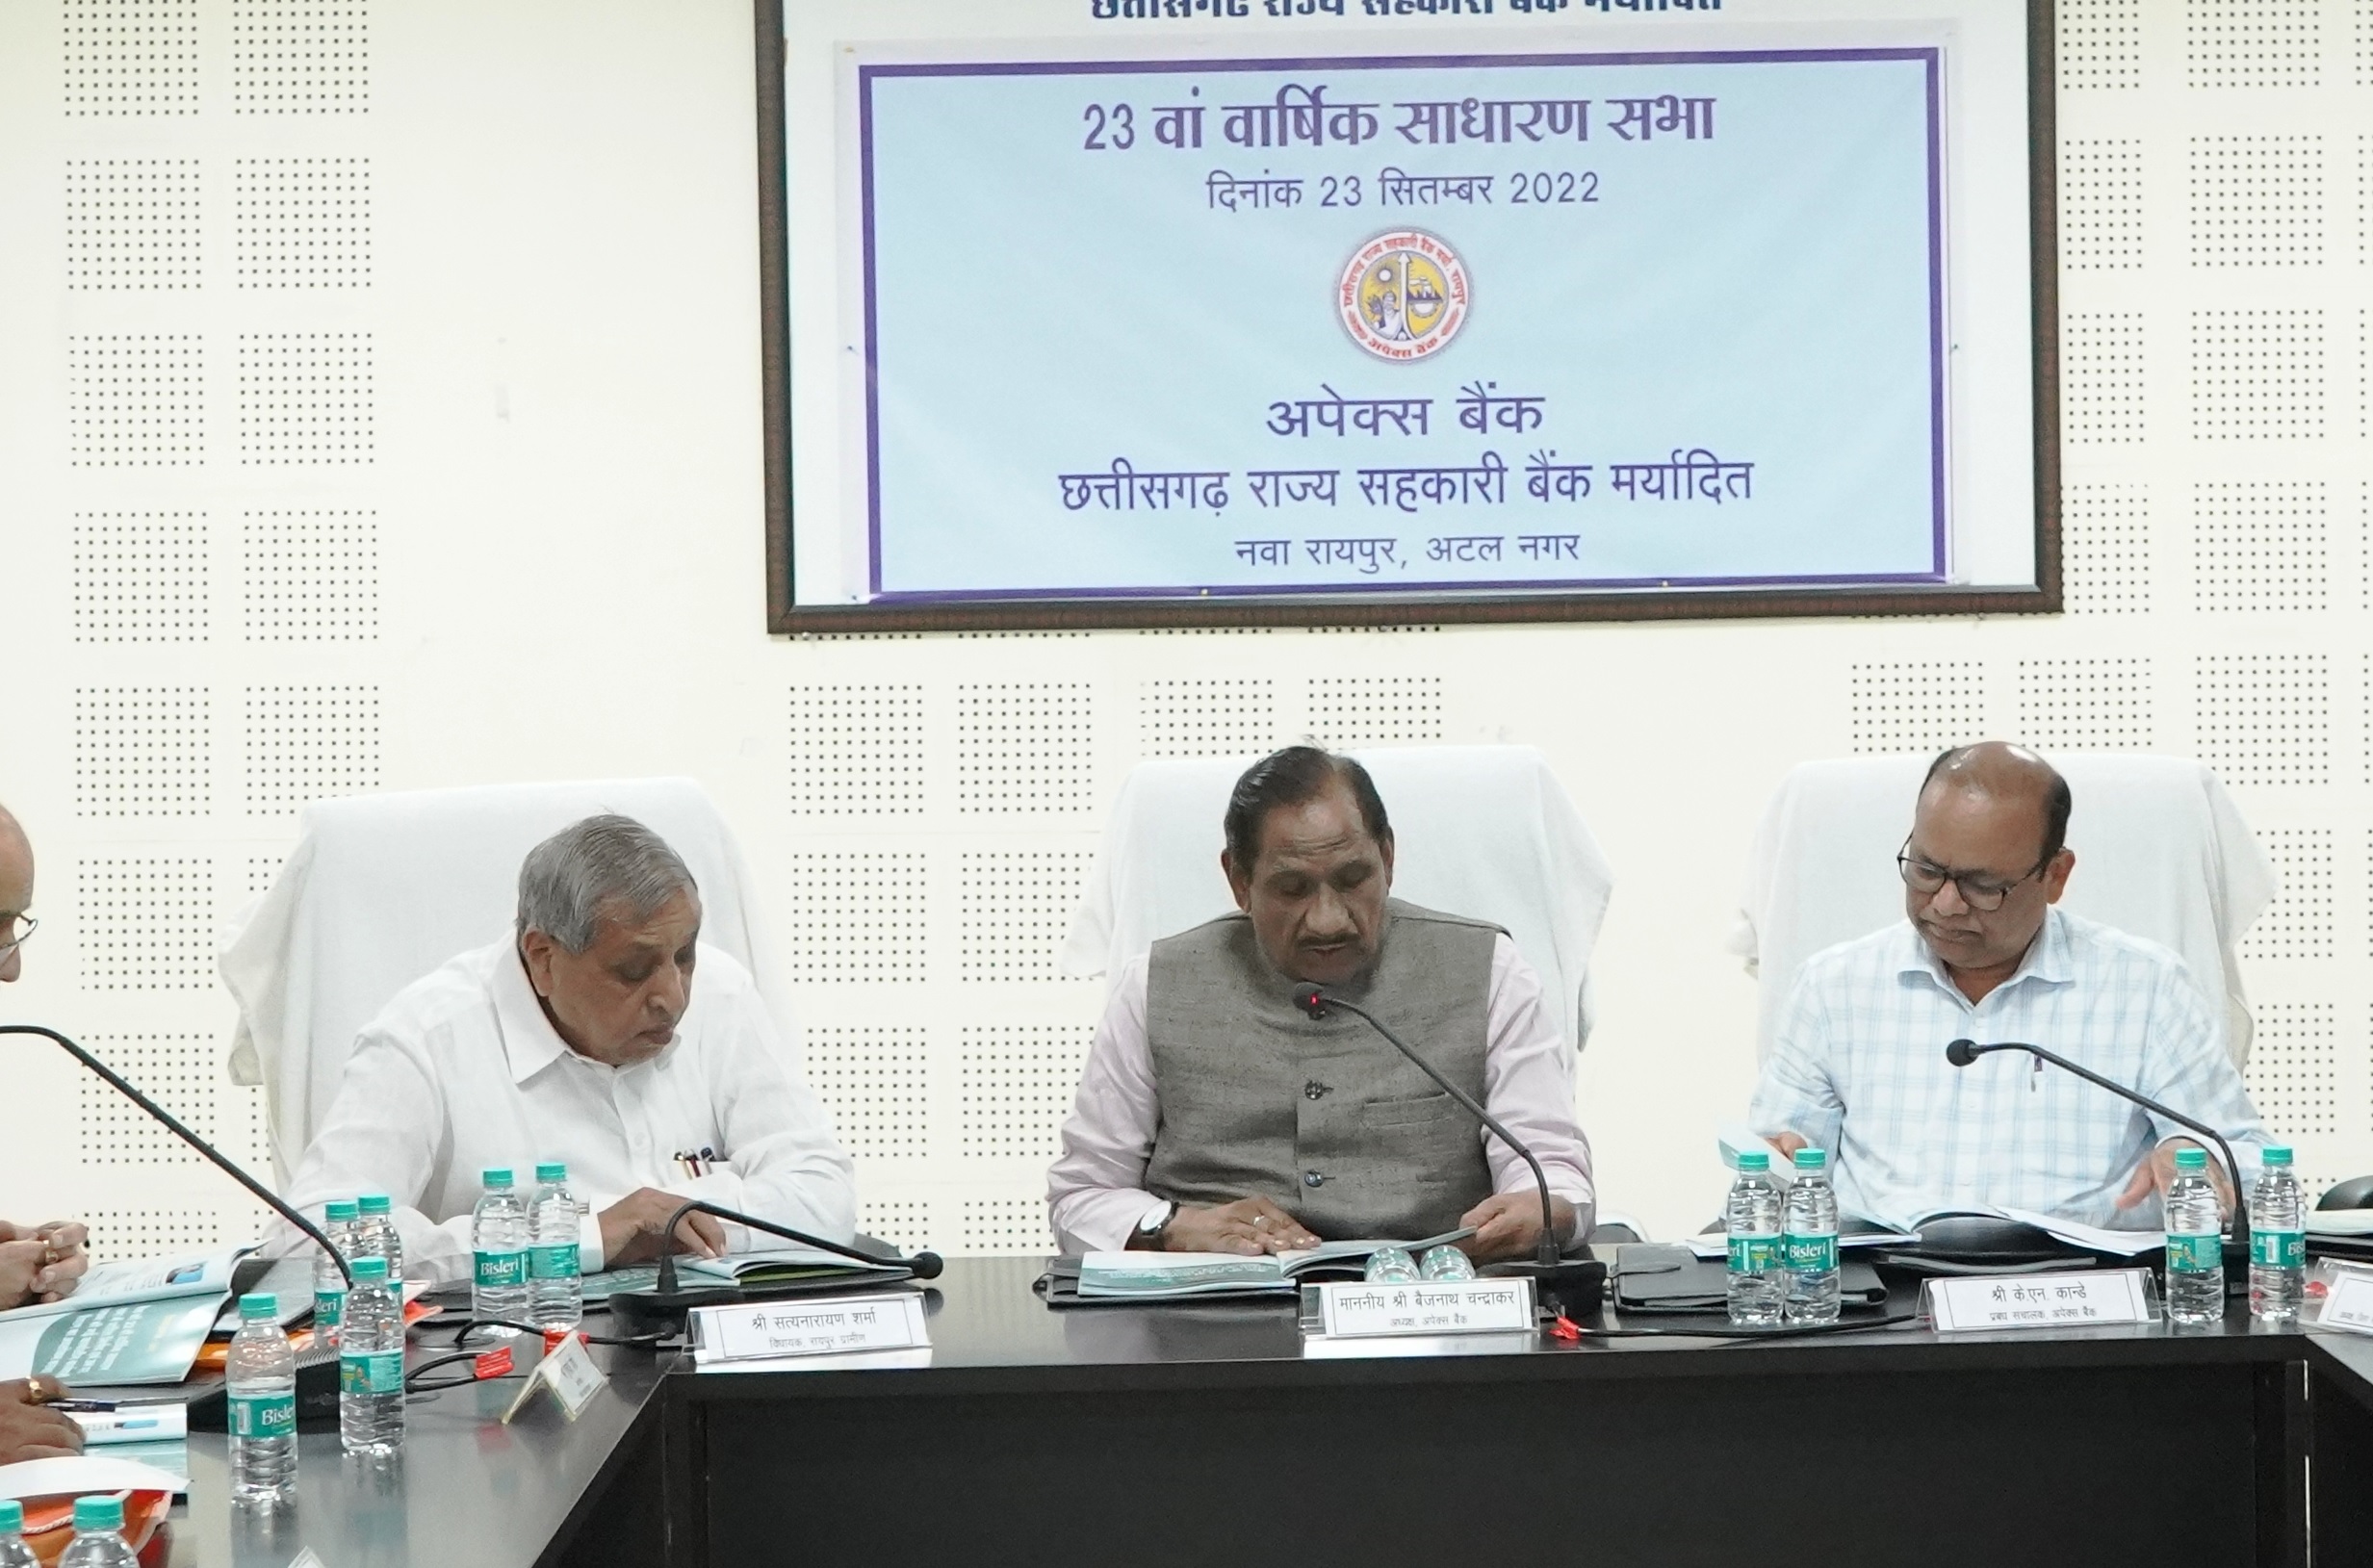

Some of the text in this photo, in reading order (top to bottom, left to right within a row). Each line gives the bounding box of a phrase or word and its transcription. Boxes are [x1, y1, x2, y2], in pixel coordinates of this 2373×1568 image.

[1083, 83, 1717, 150] 23 वां वार्षिक साधारण सभा
[1204, 166, 1599, 214] दिनांक 23 सितम्बर 2022
[1265, 379, 1547, 439] अपेक्स बैंक
[1057, 448, 1756, 518] छत्तीसगढ़ राज्य सहकारी बैंक मर्यादित
[1233, 534, 1582, 575] नवा रायपुर, अटल नगर
[481, 1257, 519, 1276] Bisleri
[1789, 1242, 1825, 1259] Bisleri
[1338, 1289, 1515, 1311] माननीय श्री बैजनाथ चन्द्राकर
[1991, 1284, 2007, 1303] श्री
[751, 1305, 877, 1331] श्री सत्यनारायण शर्मा
